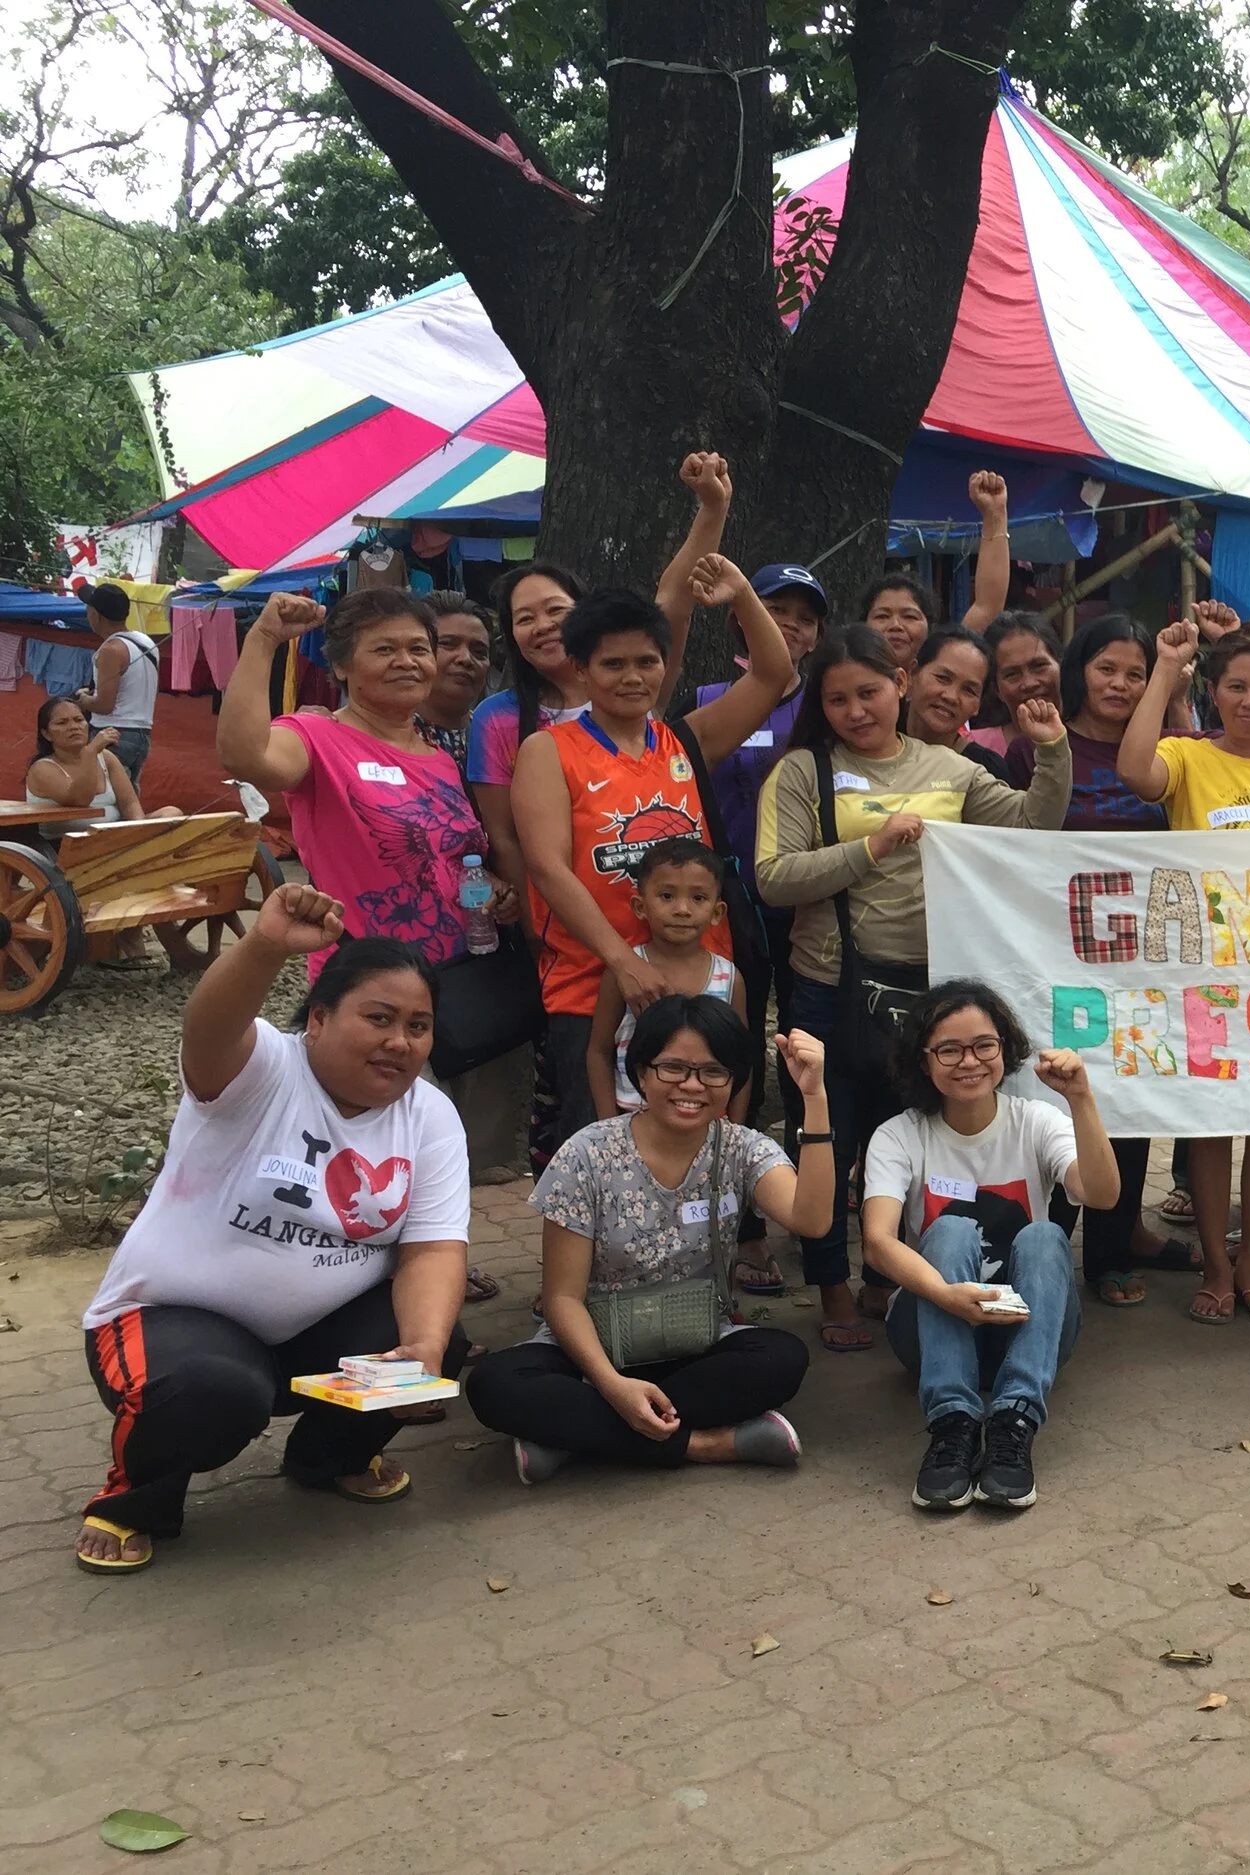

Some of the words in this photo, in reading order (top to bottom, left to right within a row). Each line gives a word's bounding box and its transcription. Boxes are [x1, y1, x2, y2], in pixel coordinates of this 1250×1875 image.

[262, 1158, 318, 1187] JOVILINA
[930, 1176, 963, 1196] FAYE
[690, 1201, 729, 1219] ROA
[228, 1203, 360, 1249] LANGK
